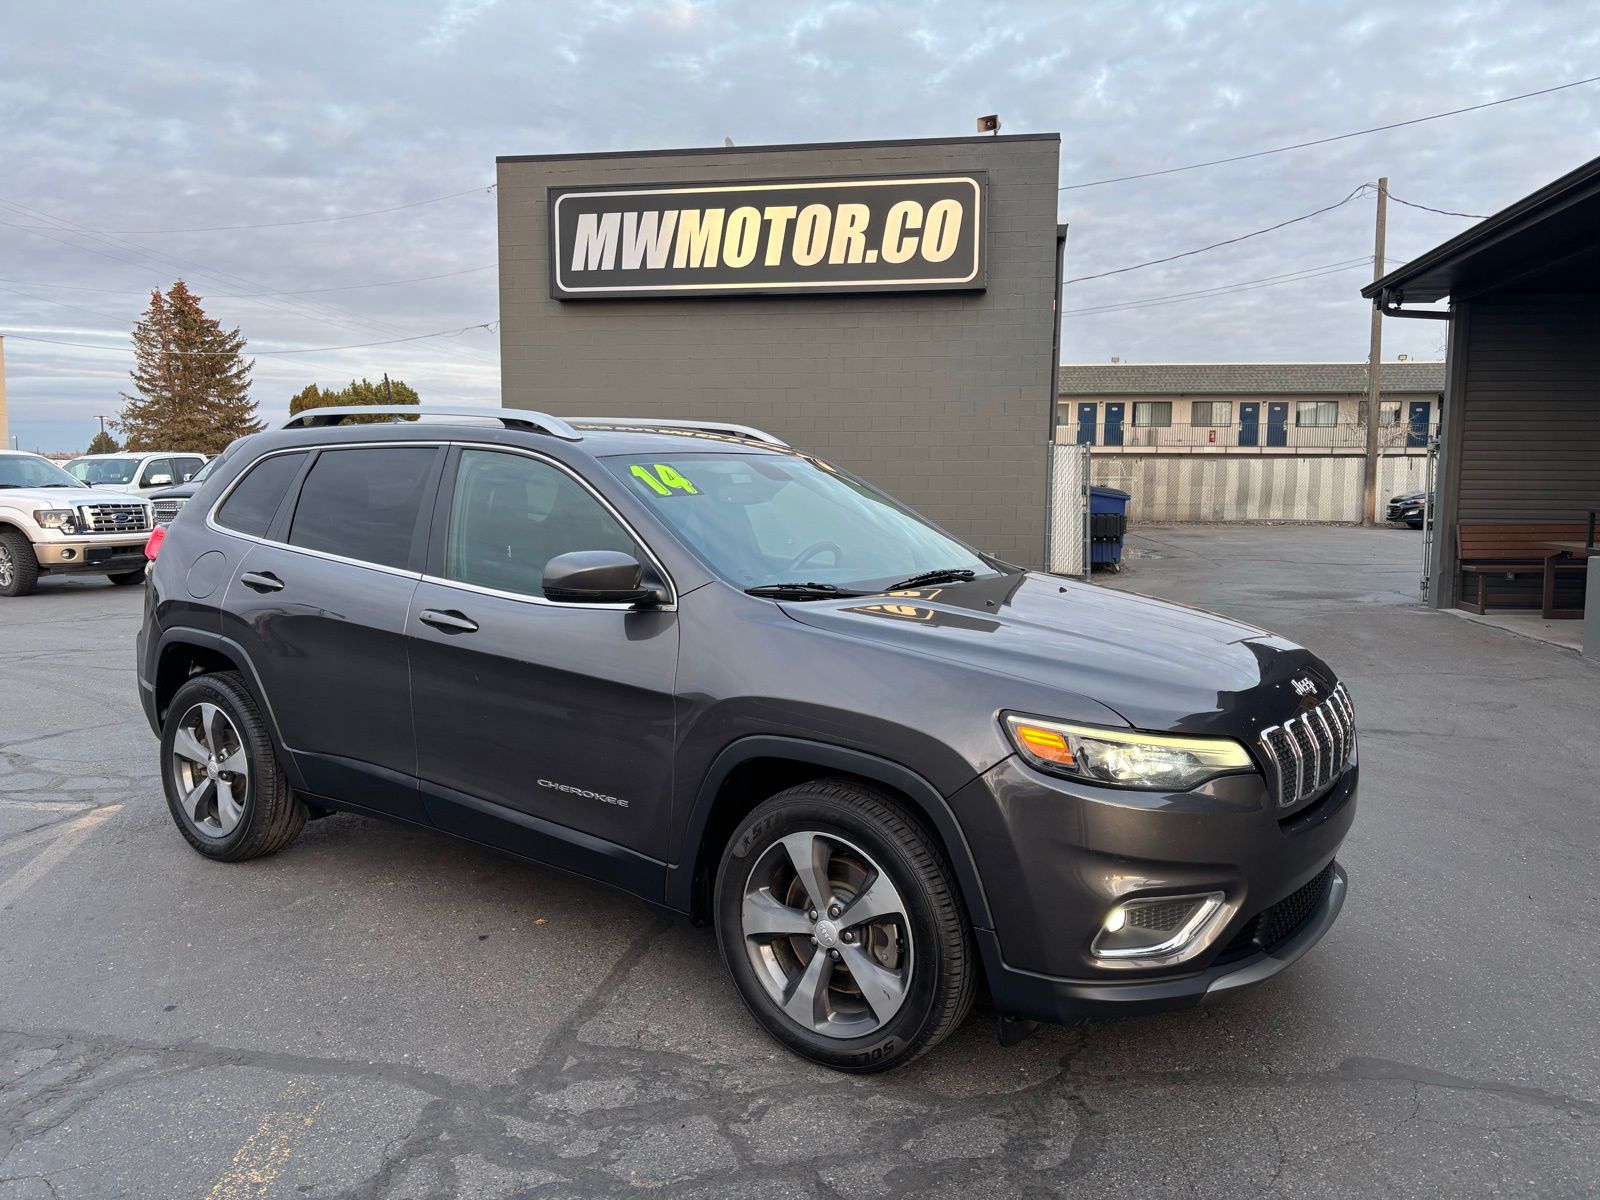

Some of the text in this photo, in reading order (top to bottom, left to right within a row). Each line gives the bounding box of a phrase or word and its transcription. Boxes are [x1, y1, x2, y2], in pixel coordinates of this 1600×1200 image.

[571, 199, 963, 271] MWMOTOR.CO
[630, 464, 698, 496] 14
[1290, 677, 1318, 696] Jeep
[536, 779, 629, 808] CHEROKEE
